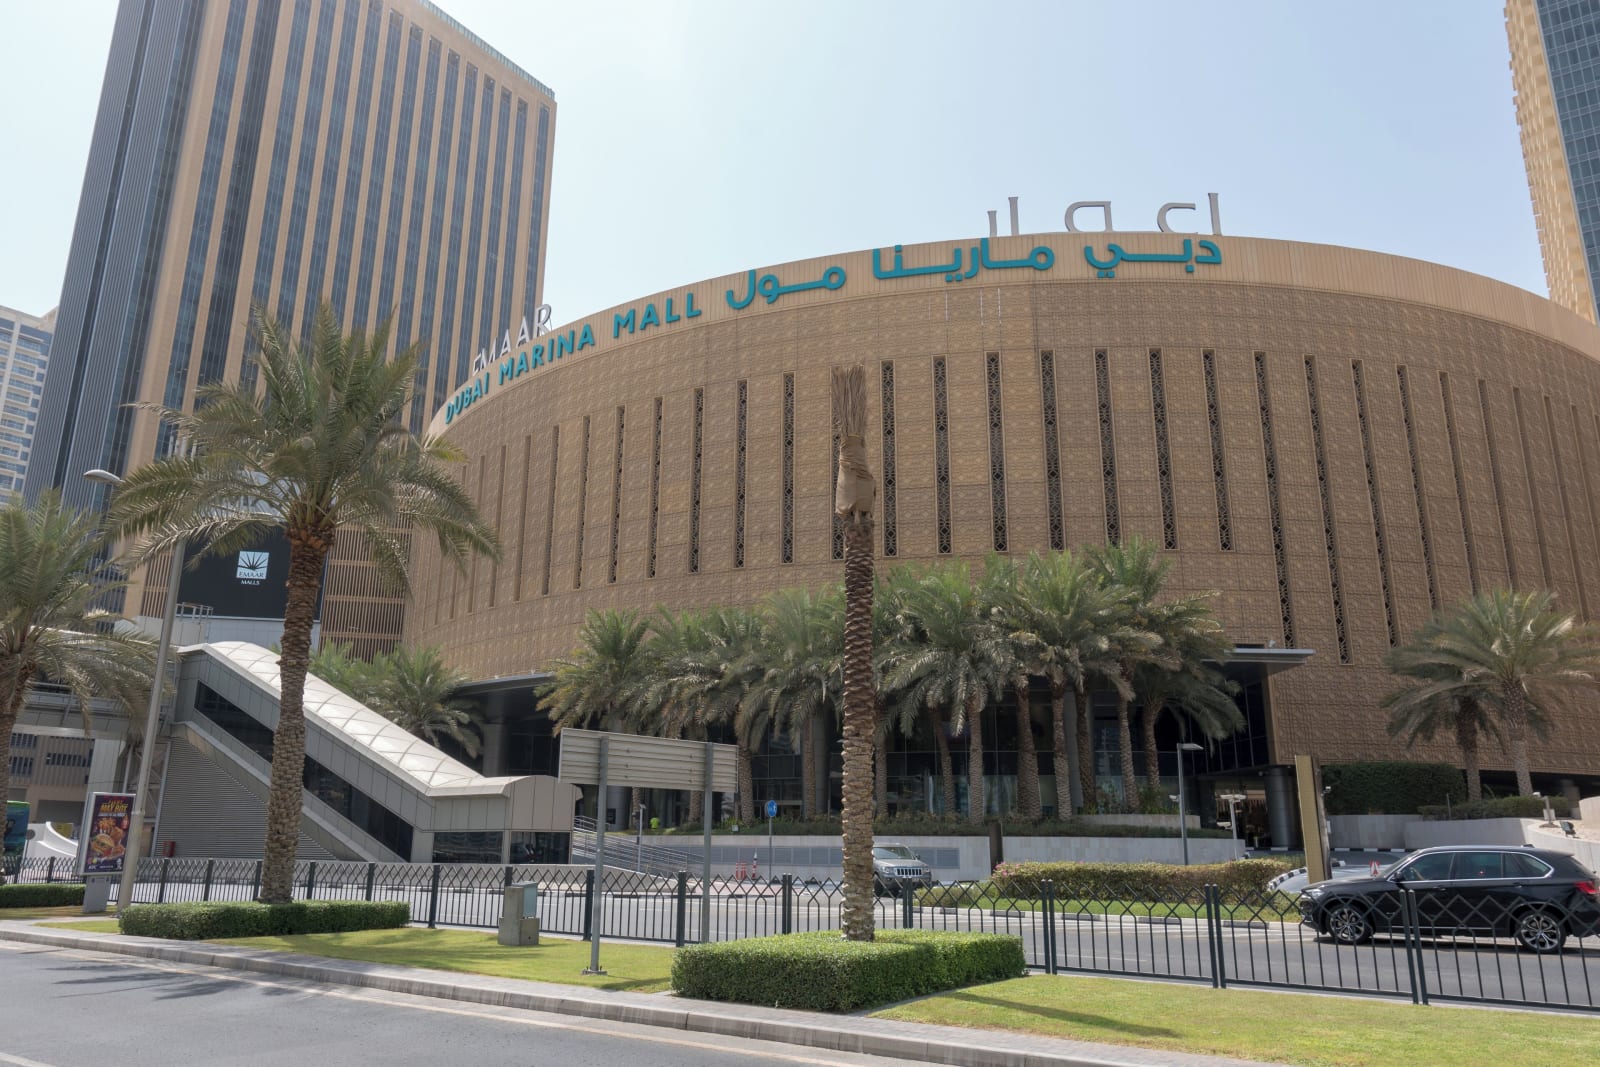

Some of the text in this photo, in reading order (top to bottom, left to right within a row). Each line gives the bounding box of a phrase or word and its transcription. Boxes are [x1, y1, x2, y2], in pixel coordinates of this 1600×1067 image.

[726, 237, 1222, 310] دبي مارينا مول
[445, 293, 702, 424] DUBAI MARINA MALL
